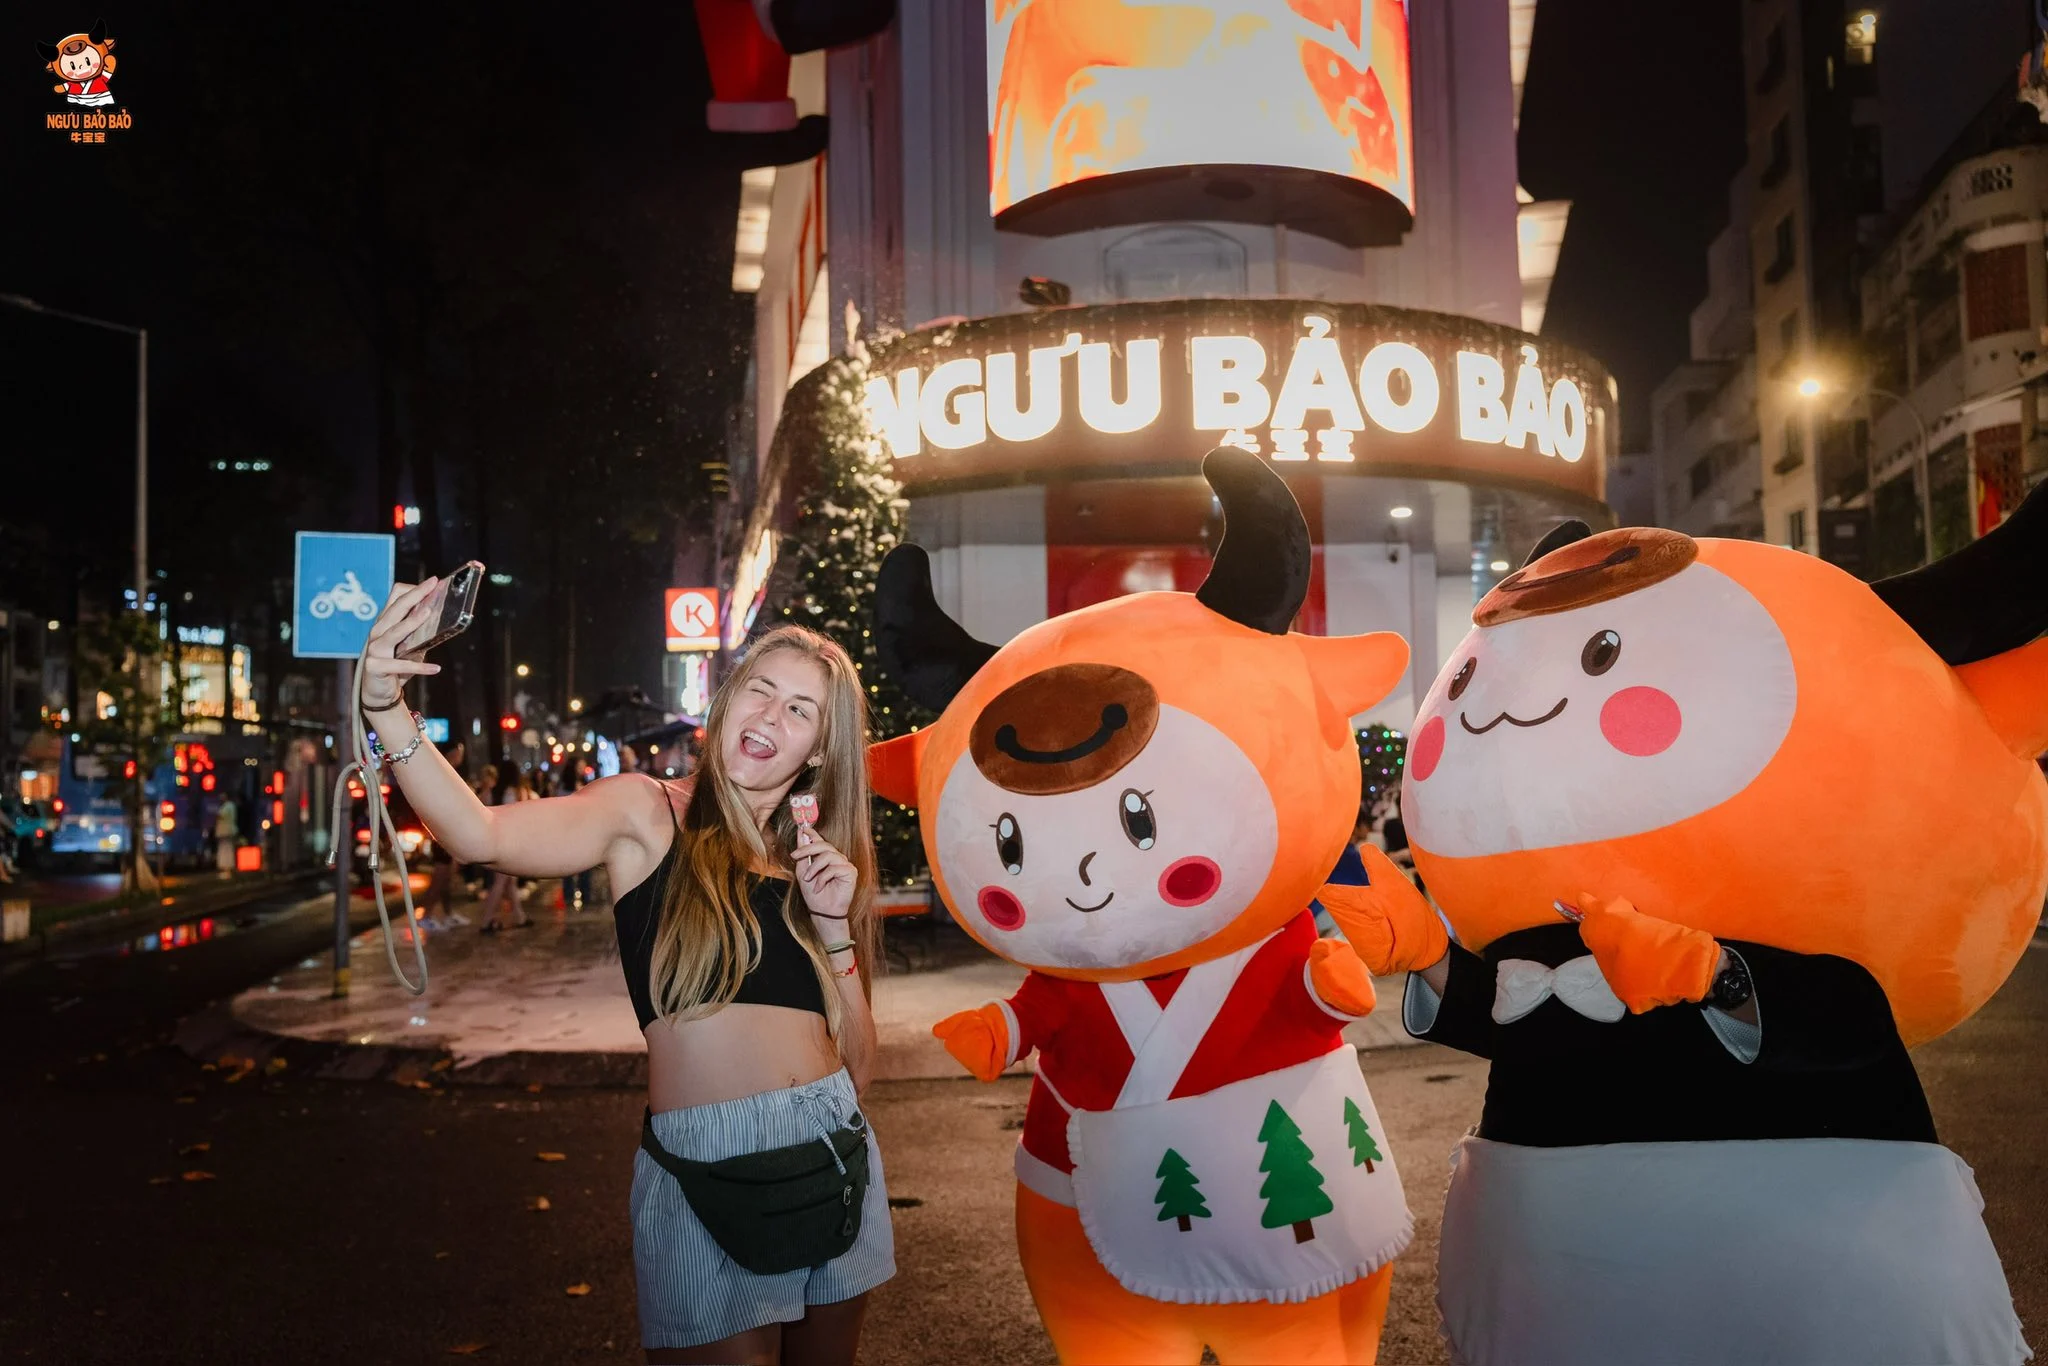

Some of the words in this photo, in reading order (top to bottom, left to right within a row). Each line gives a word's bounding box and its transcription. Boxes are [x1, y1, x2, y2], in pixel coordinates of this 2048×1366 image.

[863, 333, 1162, 459] NGƯU
[1191, 315, 1440, 433] BẢO
[1456, 345, 1587, 463] BẢO
[685, 604, 709, 630] K
